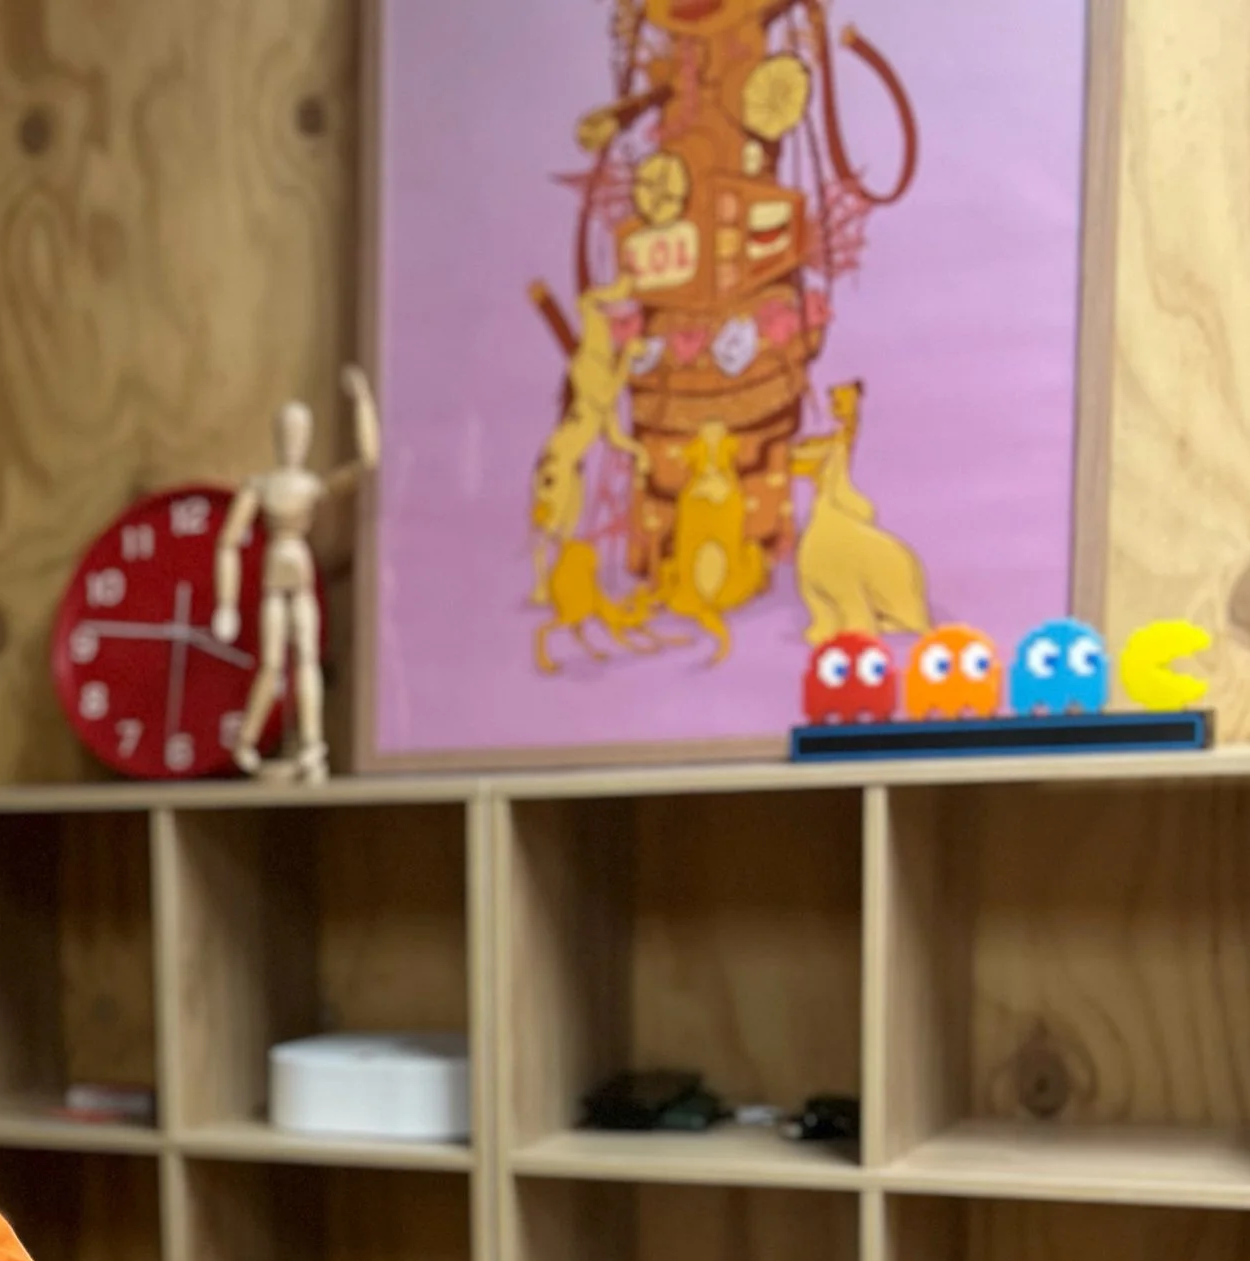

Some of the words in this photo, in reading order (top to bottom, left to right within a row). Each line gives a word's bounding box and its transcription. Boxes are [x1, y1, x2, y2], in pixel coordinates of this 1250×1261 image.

[171, 496, 210, 537] 12
[121, 525, 155, 561] 11
[86, 568, 126, 607] 10
[70, 625, 99, 664] 9
[79, 681, 109, 720] 8
[116, 719, 144, 759] 7
[164, 732, 194, 771] 6
